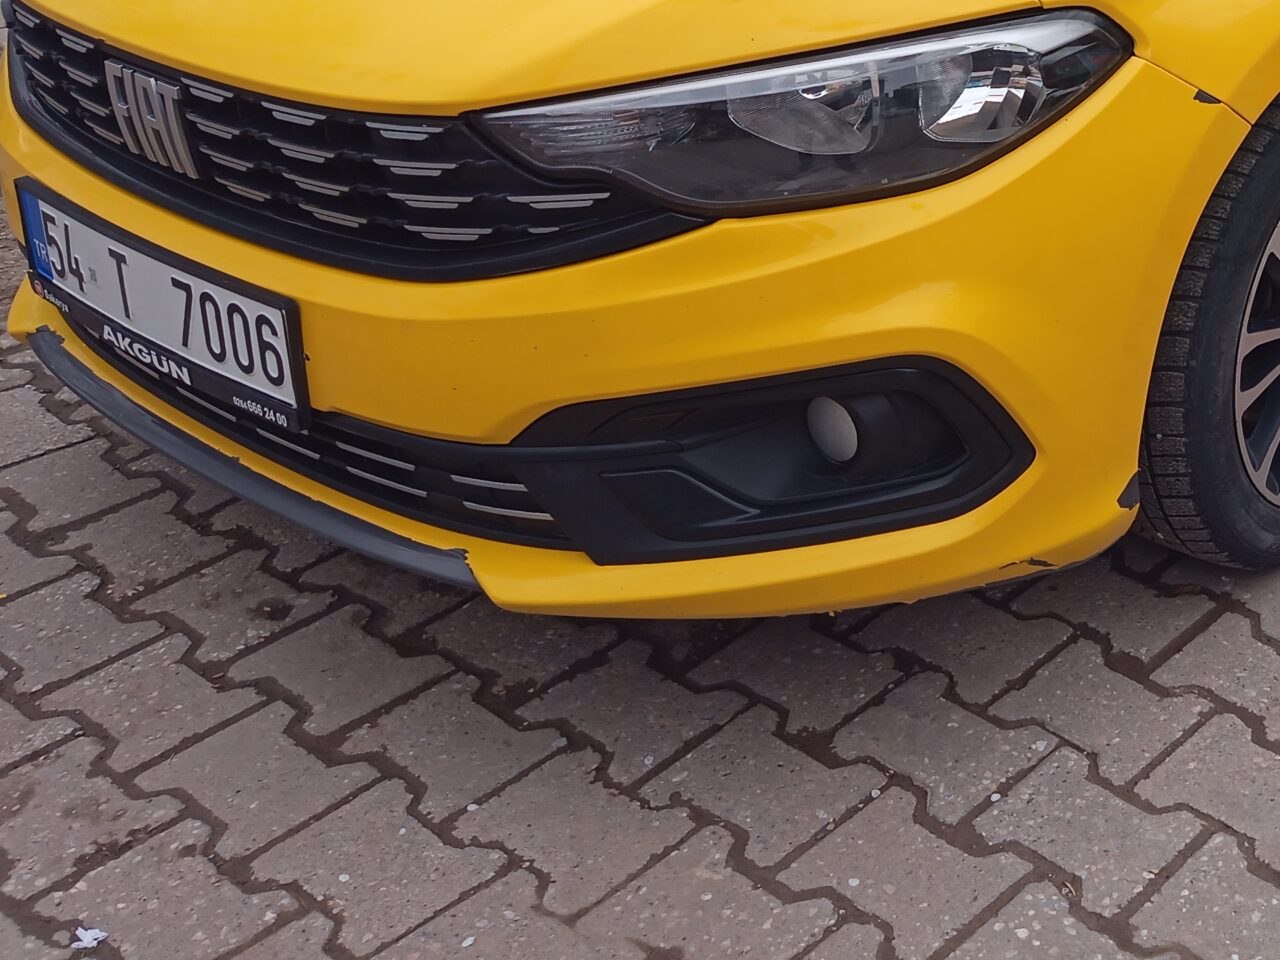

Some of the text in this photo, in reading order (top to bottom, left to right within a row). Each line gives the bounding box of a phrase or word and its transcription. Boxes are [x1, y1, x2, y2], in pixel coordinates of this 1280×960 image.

[104, 59, 199, 179] FIAT
[40, 209, 86, 293] 54
[108, 246, 130, 321] T
[170, 276, 286, 387] 7006
[102, 324, 192, 386] AKGÜN
[264, 407, 276, 422] 24
[275, 412, 288, 428] 00
